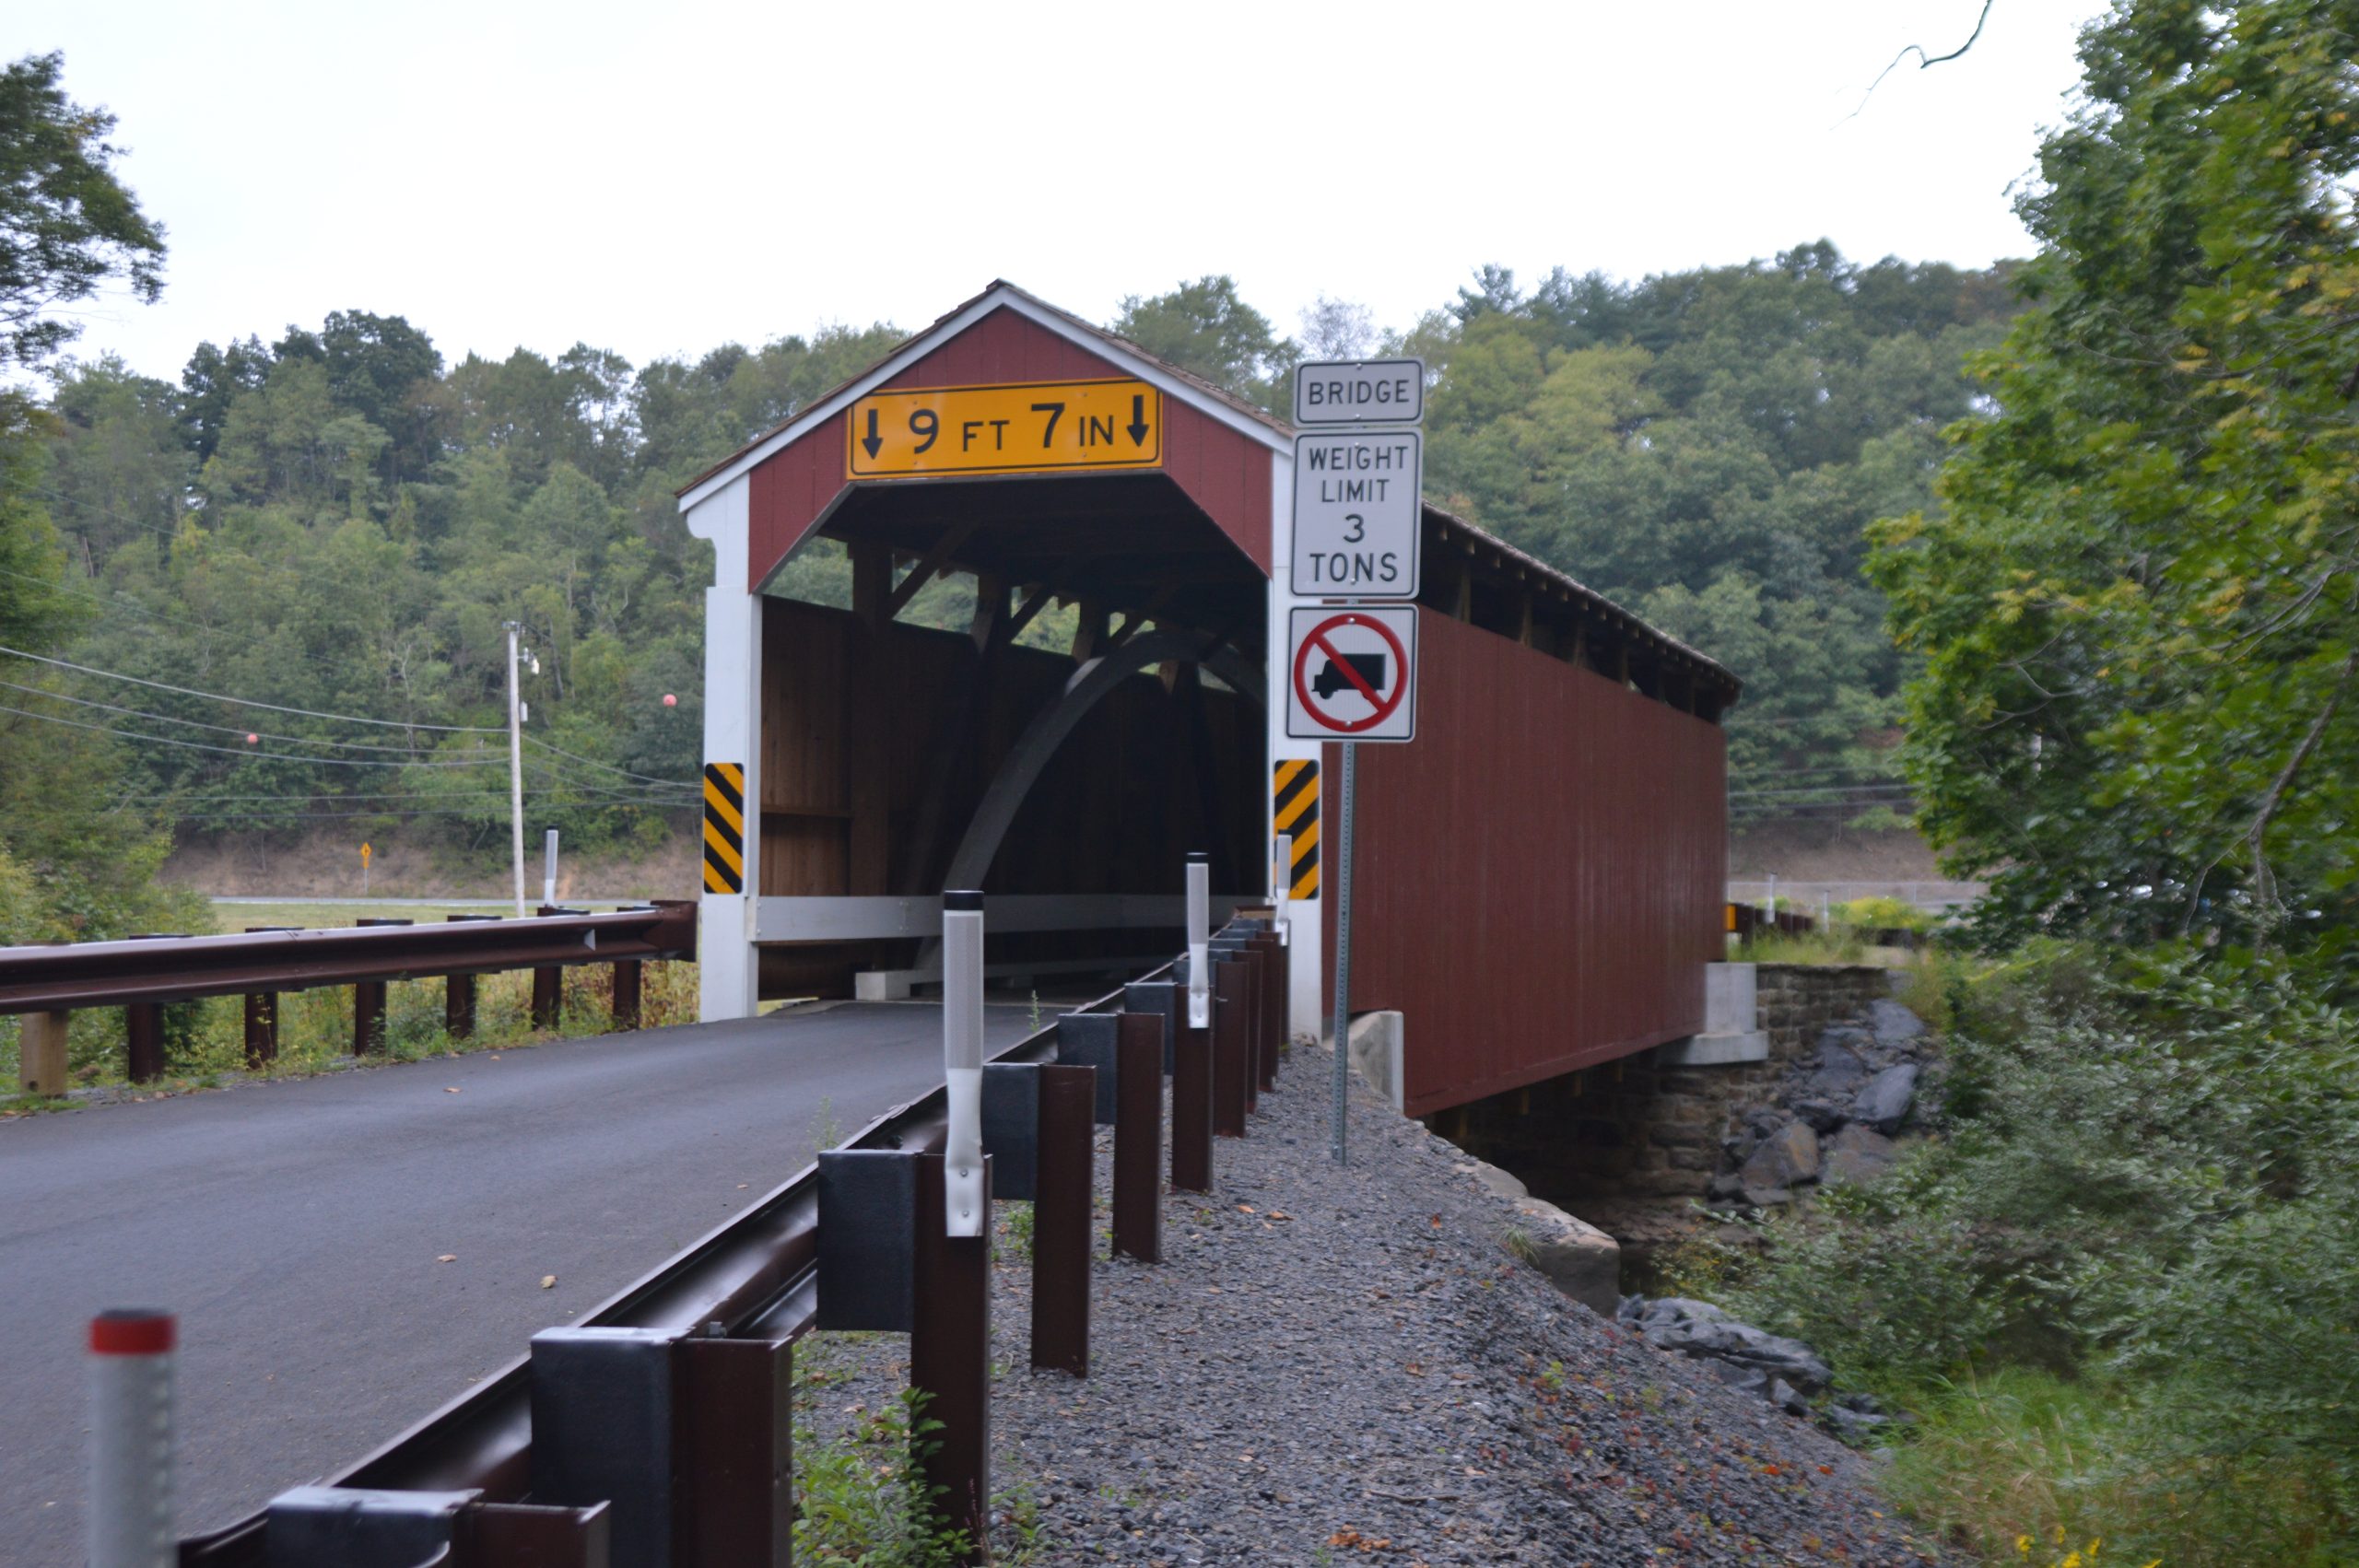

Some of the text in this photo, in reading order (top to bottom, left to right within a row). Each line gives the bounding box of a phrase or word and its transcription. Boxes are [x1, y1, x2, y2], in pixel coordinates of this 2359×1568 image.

[1309, 380, 1410, 405] BRIDGE
[909, 402, 1114, 454] 9 FT 7 IN
[1309, 446, 1409, 471] WEIGHT
[1321, 479, 1391, 503] LIMIT
[1343, 513, 1365, 544] 3
[1309, 552, 1399, 582] TONS
